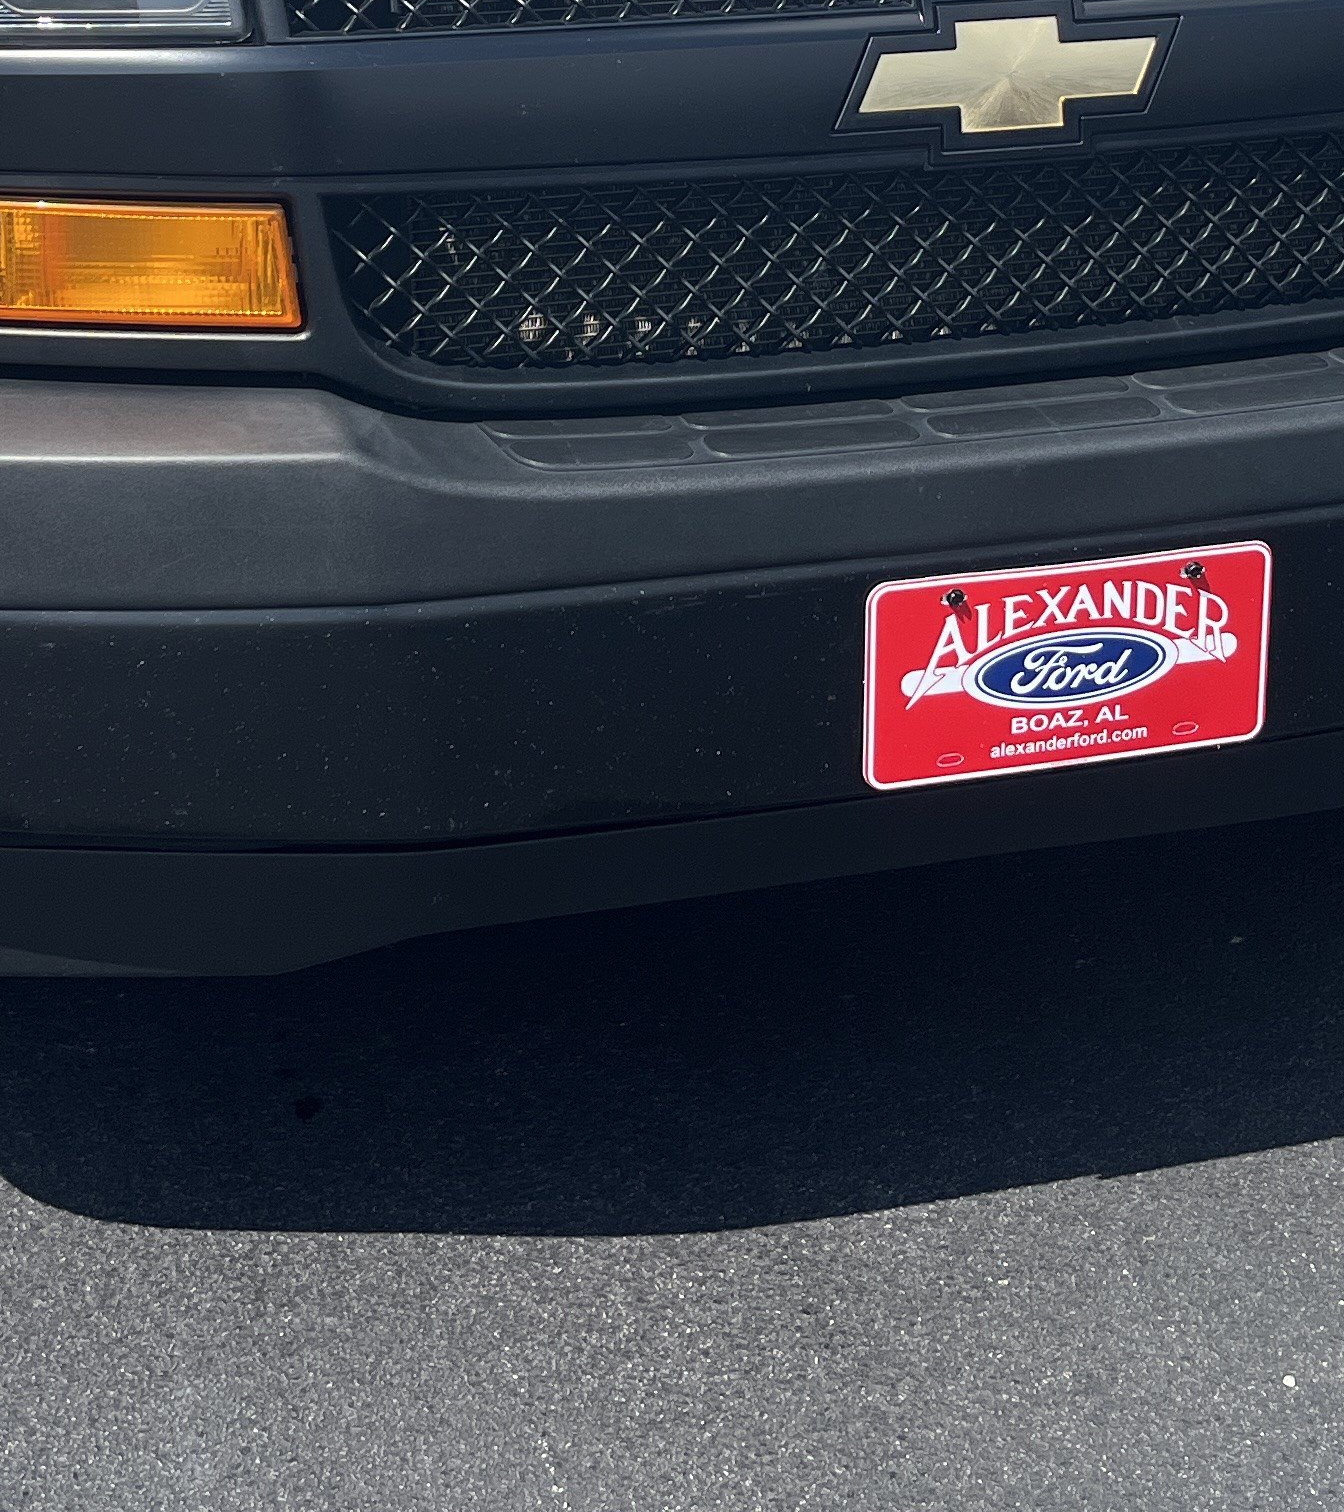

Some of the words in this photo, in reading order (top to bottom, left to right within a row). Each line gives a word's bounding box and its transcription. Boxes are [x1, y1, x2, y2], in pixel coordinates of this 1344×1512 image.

[906, 580, 1229, 710] ALEXANDER
[1011, 642, 1133, 694] Ford
[1010, 709, 1089, 735] BOAZ,
[1095, 704, 1129, 723] AL
[990, 724, 1148, 759] alexanderford.com
